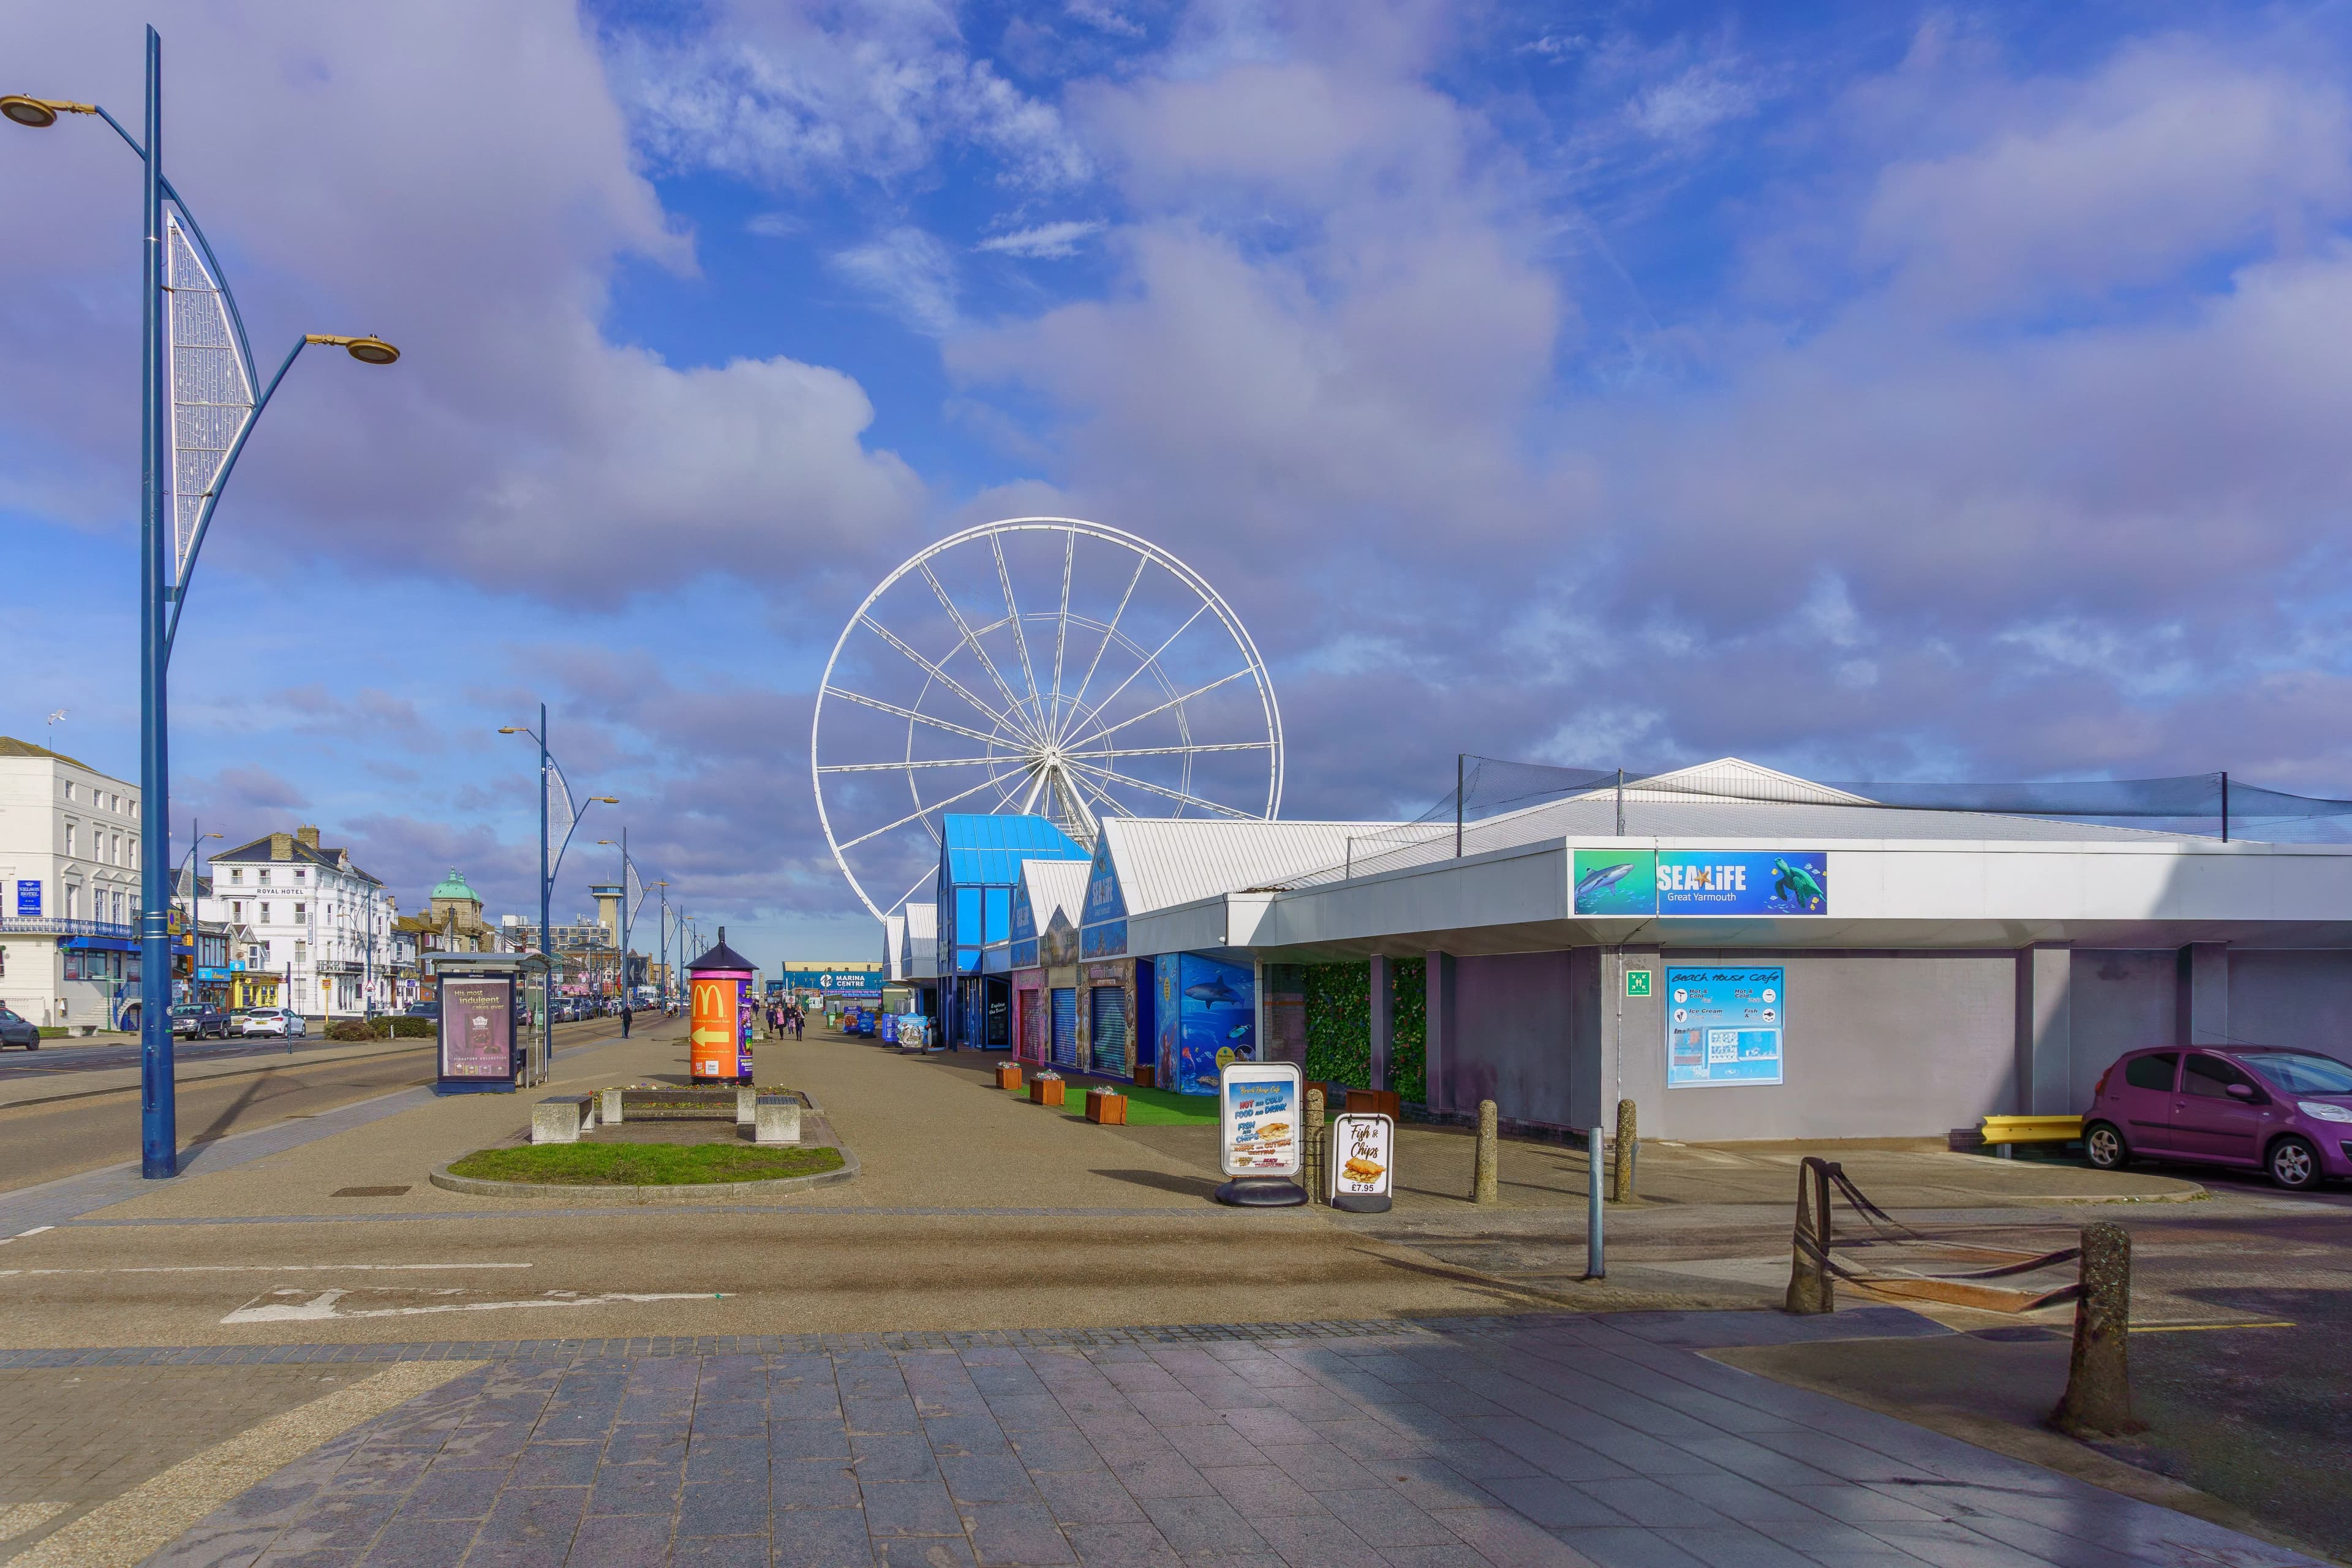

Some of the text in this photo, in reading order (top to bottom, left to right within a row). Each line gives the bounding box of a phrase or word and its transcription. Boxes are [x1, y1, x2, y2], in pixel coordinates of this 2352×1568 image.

[1658, 865, 1700, 891] SEA
[1667, 892, 1736, 901] Great Yarmouth
[1711, 973, 1745, 981] House
[459, 997, 500, 1005] indulgent
[1240, 1099, 1254, 1109] HOT
[1265, 1095, 1284, 1105] COLD
[1235, 1109, 1254, 1120] FOOD
[1265, 1103, 1287, 1114] DRINK
[1238, 1121, 1256, 1131] FISH
[1236, 1133, 1259, 1143] CHIPS
[1351, 1124, 1379, 1142] Fish &
[1264, 1139, 1292, 1148] OUTSIDE
[1351, 1142, 1379, 1160] Chips
